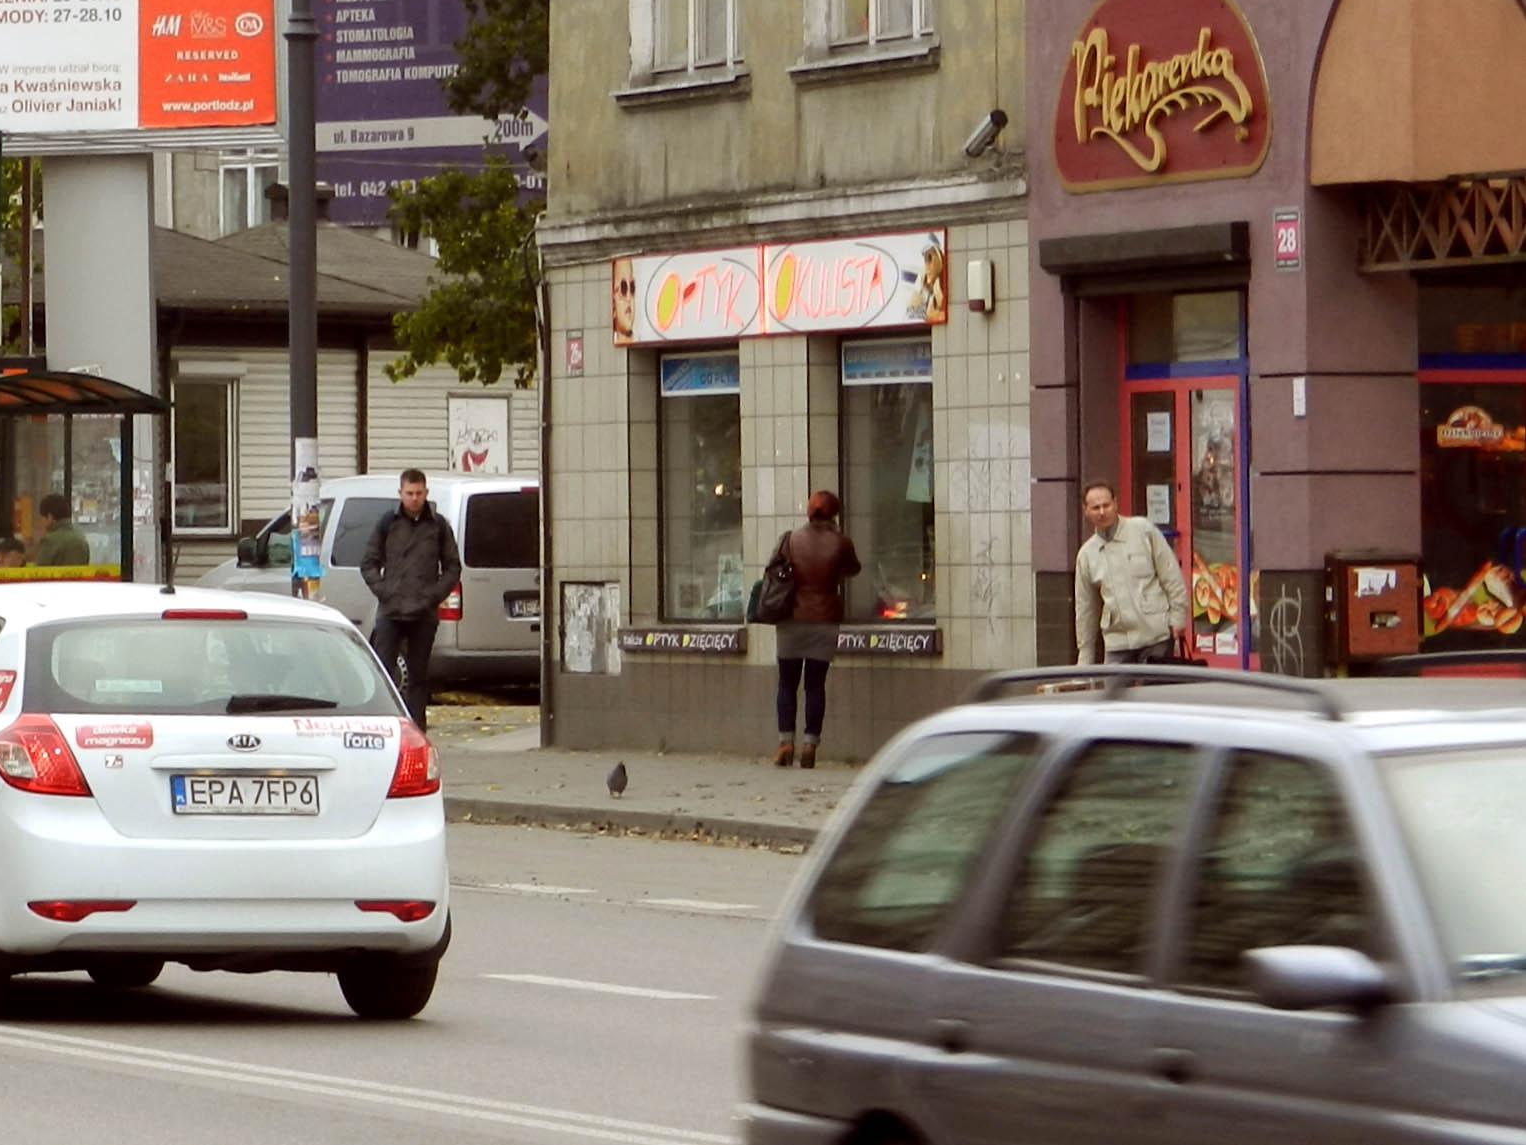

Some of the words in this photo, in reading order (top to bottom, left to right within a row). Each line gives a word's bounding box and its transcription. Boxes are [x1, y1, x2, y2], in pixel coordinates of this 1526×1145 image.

[53, 8, 122, 23] 27-28.10
[336, 8, 376, 24] APTEKA
[336, 27, 414, 44] STOMATOLOGIA
[177, 50, 239, 61] RESERVED
[336, 46, 416, 64] MAMMOGRAFIA
[336, 67, 402, 84] TOMOGRAFIA
[13, 78, 122, 93] Kwaśniewska
[1072, 27, 1253, 146] Piekarenka
[11, 99, 60, 113] Olivier
[66, 97, 122, 112] Janiak!
[162, 99, 254, 112] www.portlodz.pl
[333, 131, 346, 145] ul.
[407, 127, 415, 141] 9
[334, 181, 356, 198] tel.
[360, 178, 386, 197] 042
[1278, 228, 1297, 253] 28
[655, 263, 746, 332] OPTYK
[774, 252, 886, 322] OKULISTA
[645, 633, 679, 647] OPTYK
[837, 633, 866, 649] PTYK
[84, 736, 147, 748] magnezu
[232, 736, 257, 748] KIA
[345, 733, 384, 748] forte
[190, 779, 244, 805] EPA
[252, 779, 313, 806] 7FP6
